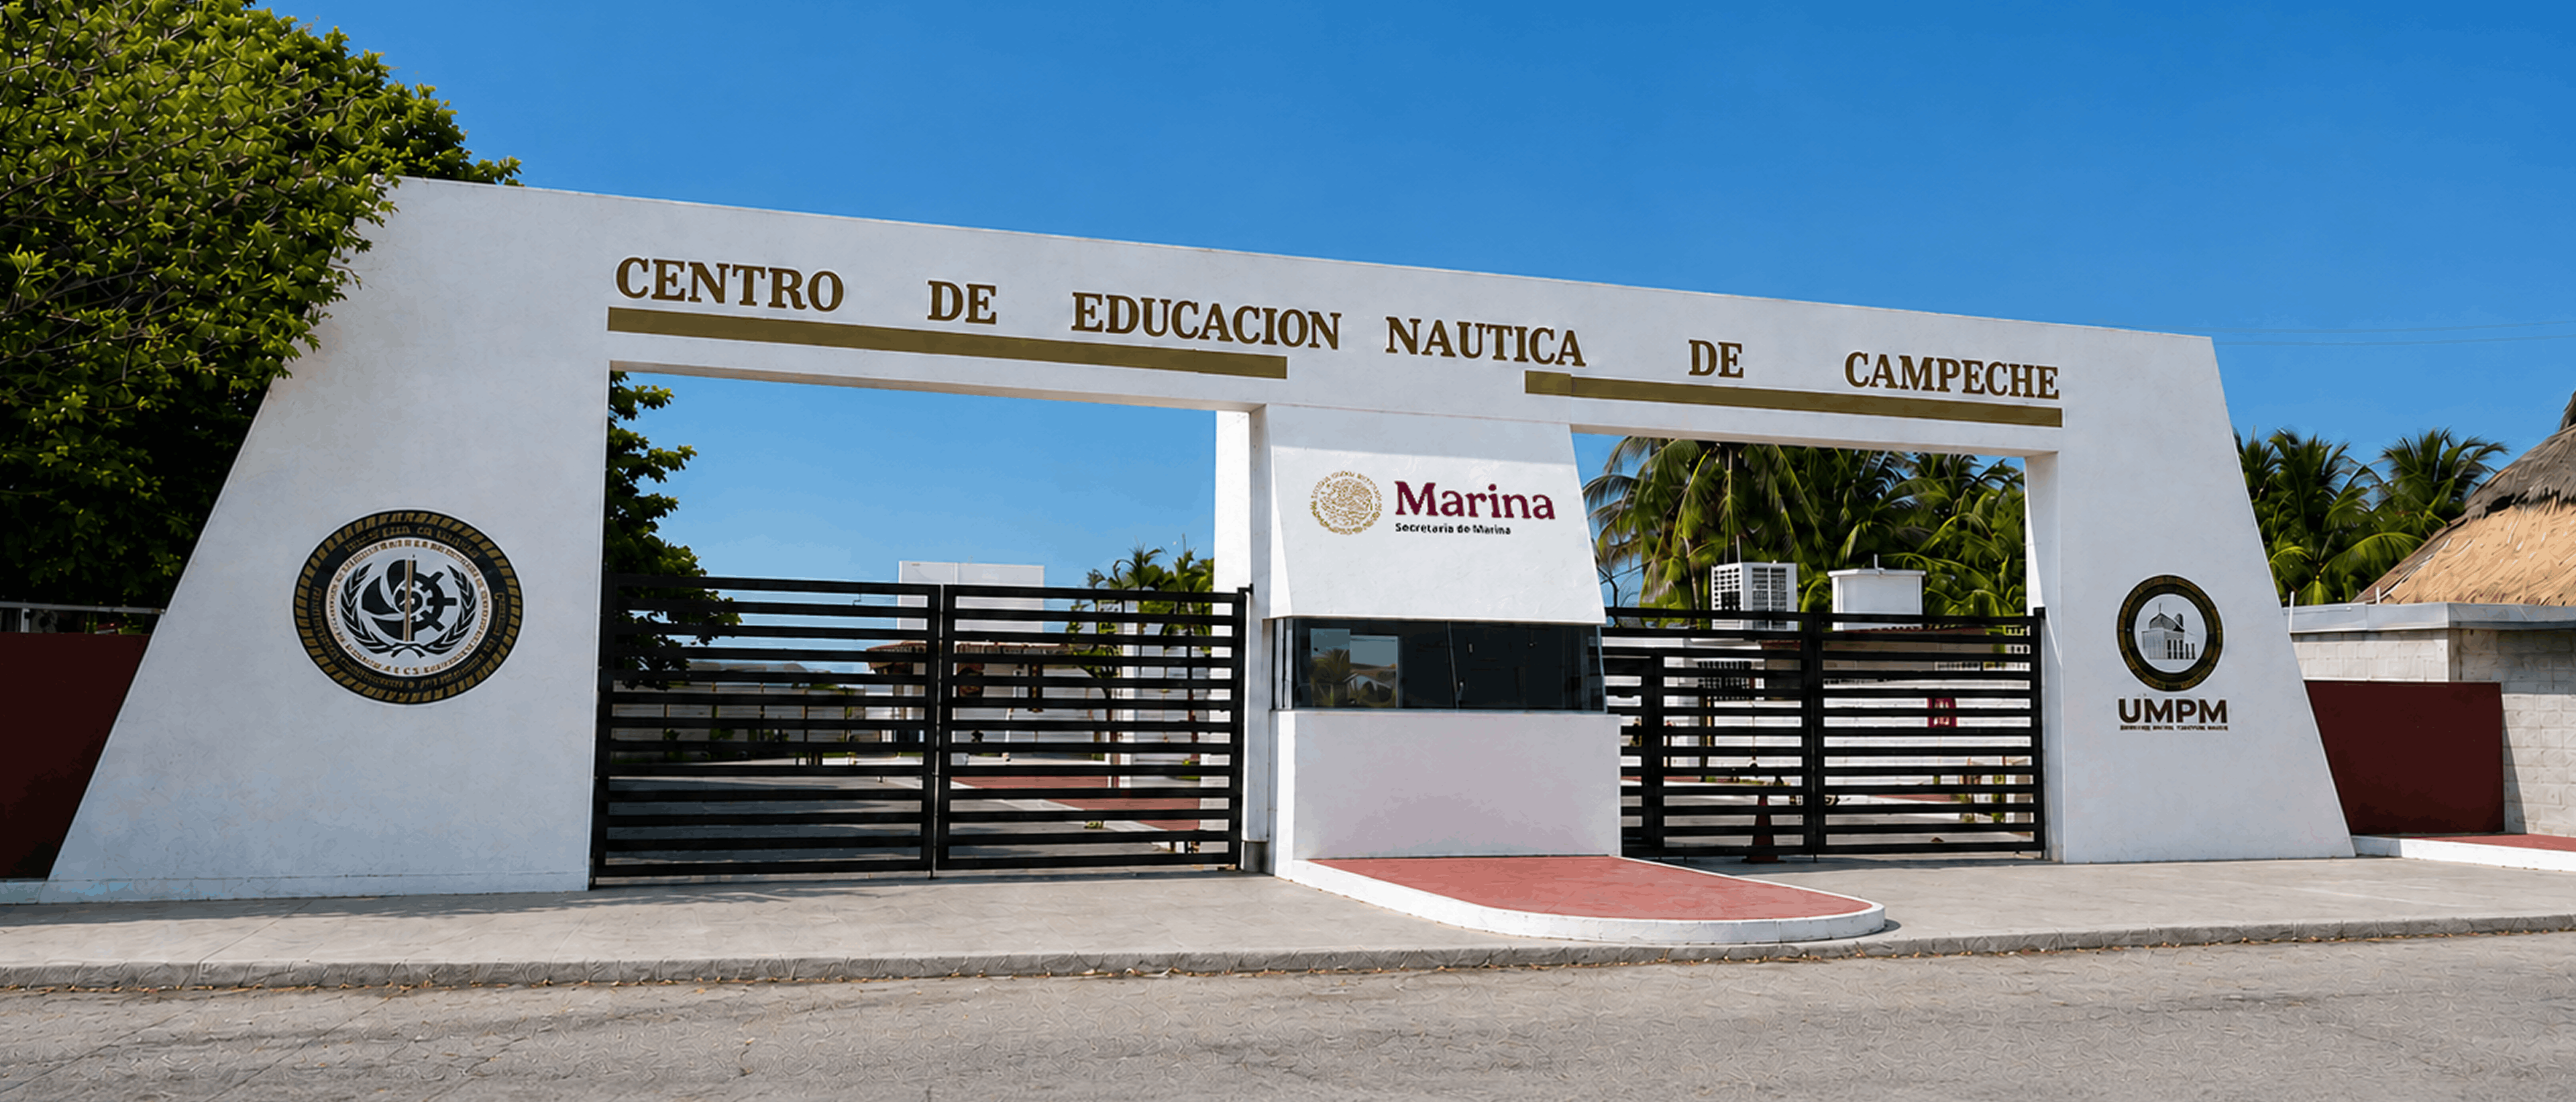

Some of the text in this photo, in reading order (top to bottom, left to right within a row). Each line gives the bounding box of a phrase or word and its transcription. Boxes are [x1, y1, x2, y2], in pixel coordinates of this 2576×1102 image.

[616, 257, 2059, 400] CENTRO DE EDUCACION NAUTICA DE CAMPECHE
[1394, 481, 1556, 520] Marina
[1456, 524, 1471, 534] de
[1472, 524, 1511, 536] Marina
[2118, 698, 2228, 724] UMPM
